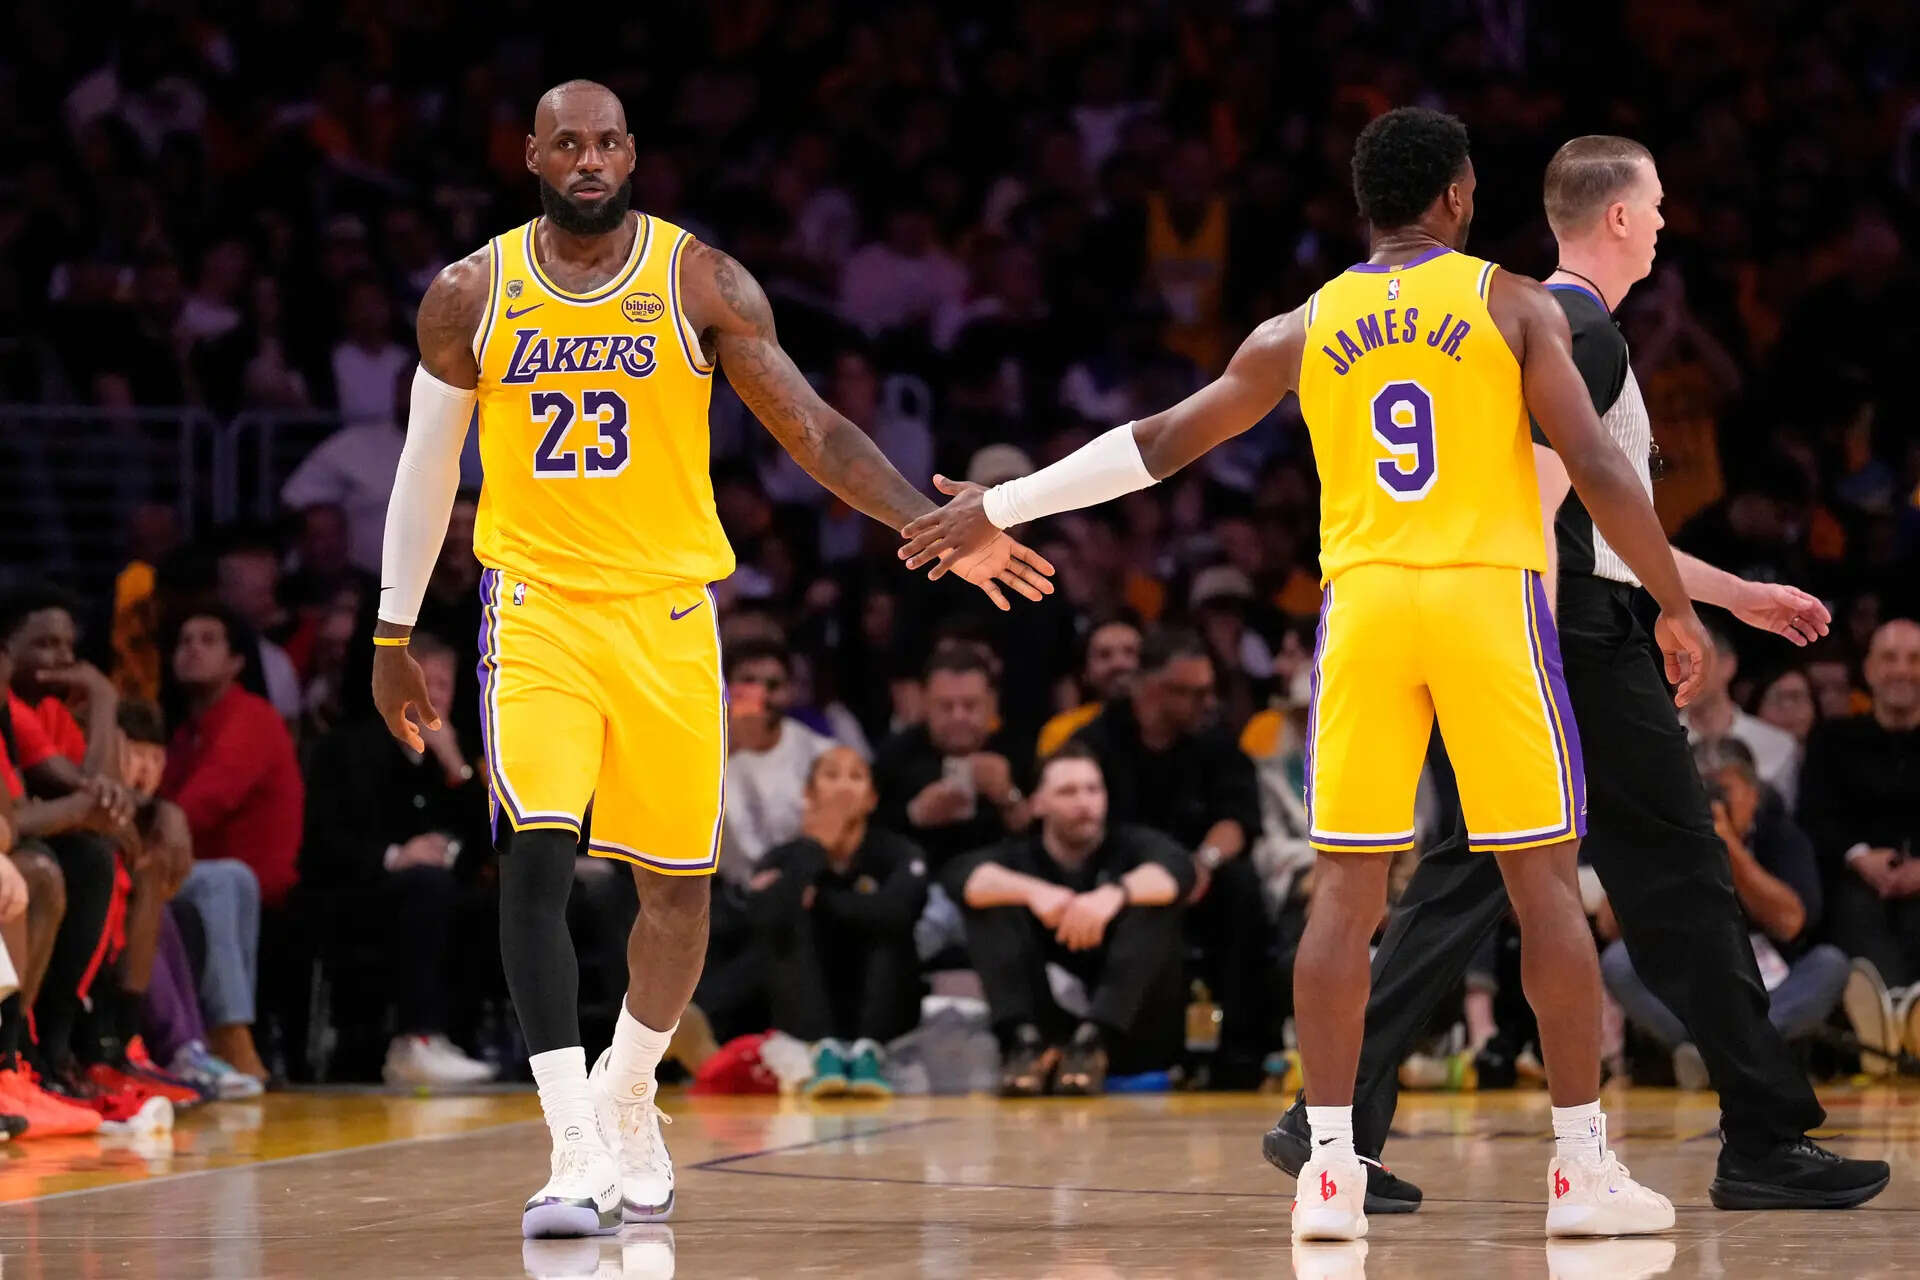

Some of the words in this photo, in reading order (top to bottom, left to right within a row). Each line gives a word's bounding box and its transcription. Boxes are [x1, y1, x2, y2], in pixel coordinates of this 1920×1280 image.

[625, 300, 662, 314] bibigo
[1322, 307, 1419, 376] JAMES
[1426, 313, 1471, 362] JR.
[501, 328, 656, 385] LAKERS
[530, 389, 631, 478] 23
[1370, 380, 1438, 502] 9
